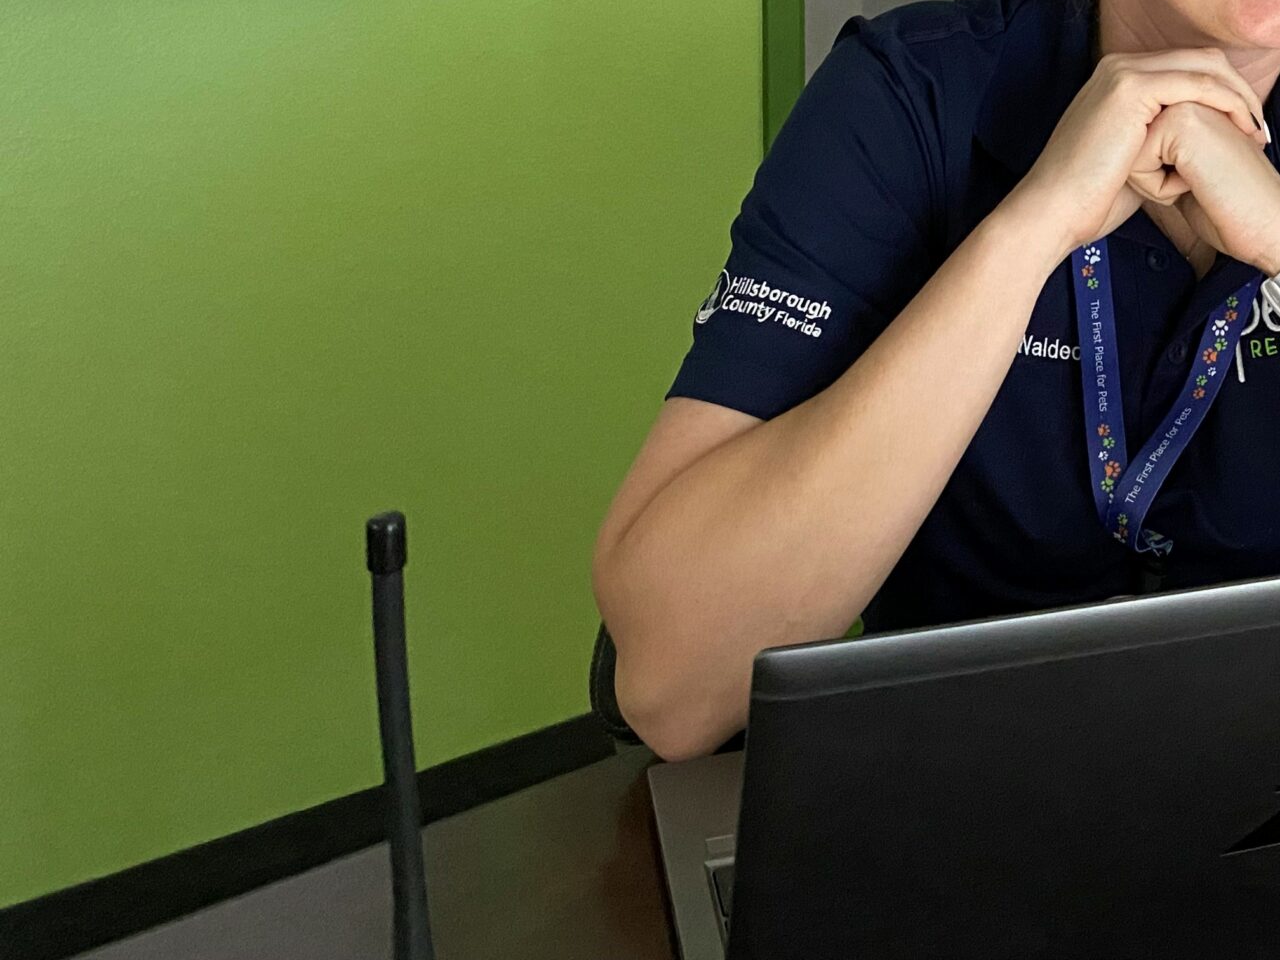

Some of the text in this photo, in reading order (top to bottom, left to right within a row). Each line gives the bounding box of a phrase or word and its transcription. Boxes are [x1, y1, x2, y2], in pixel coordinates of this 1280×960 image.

[722, 294, 822, 338] County Florida
[728, 276, 832, 320] Hillsborough
[1090, 299, 1108, 412] The First Place for Pets
[1124, 407, 1192, 503] The First Place for Pets
